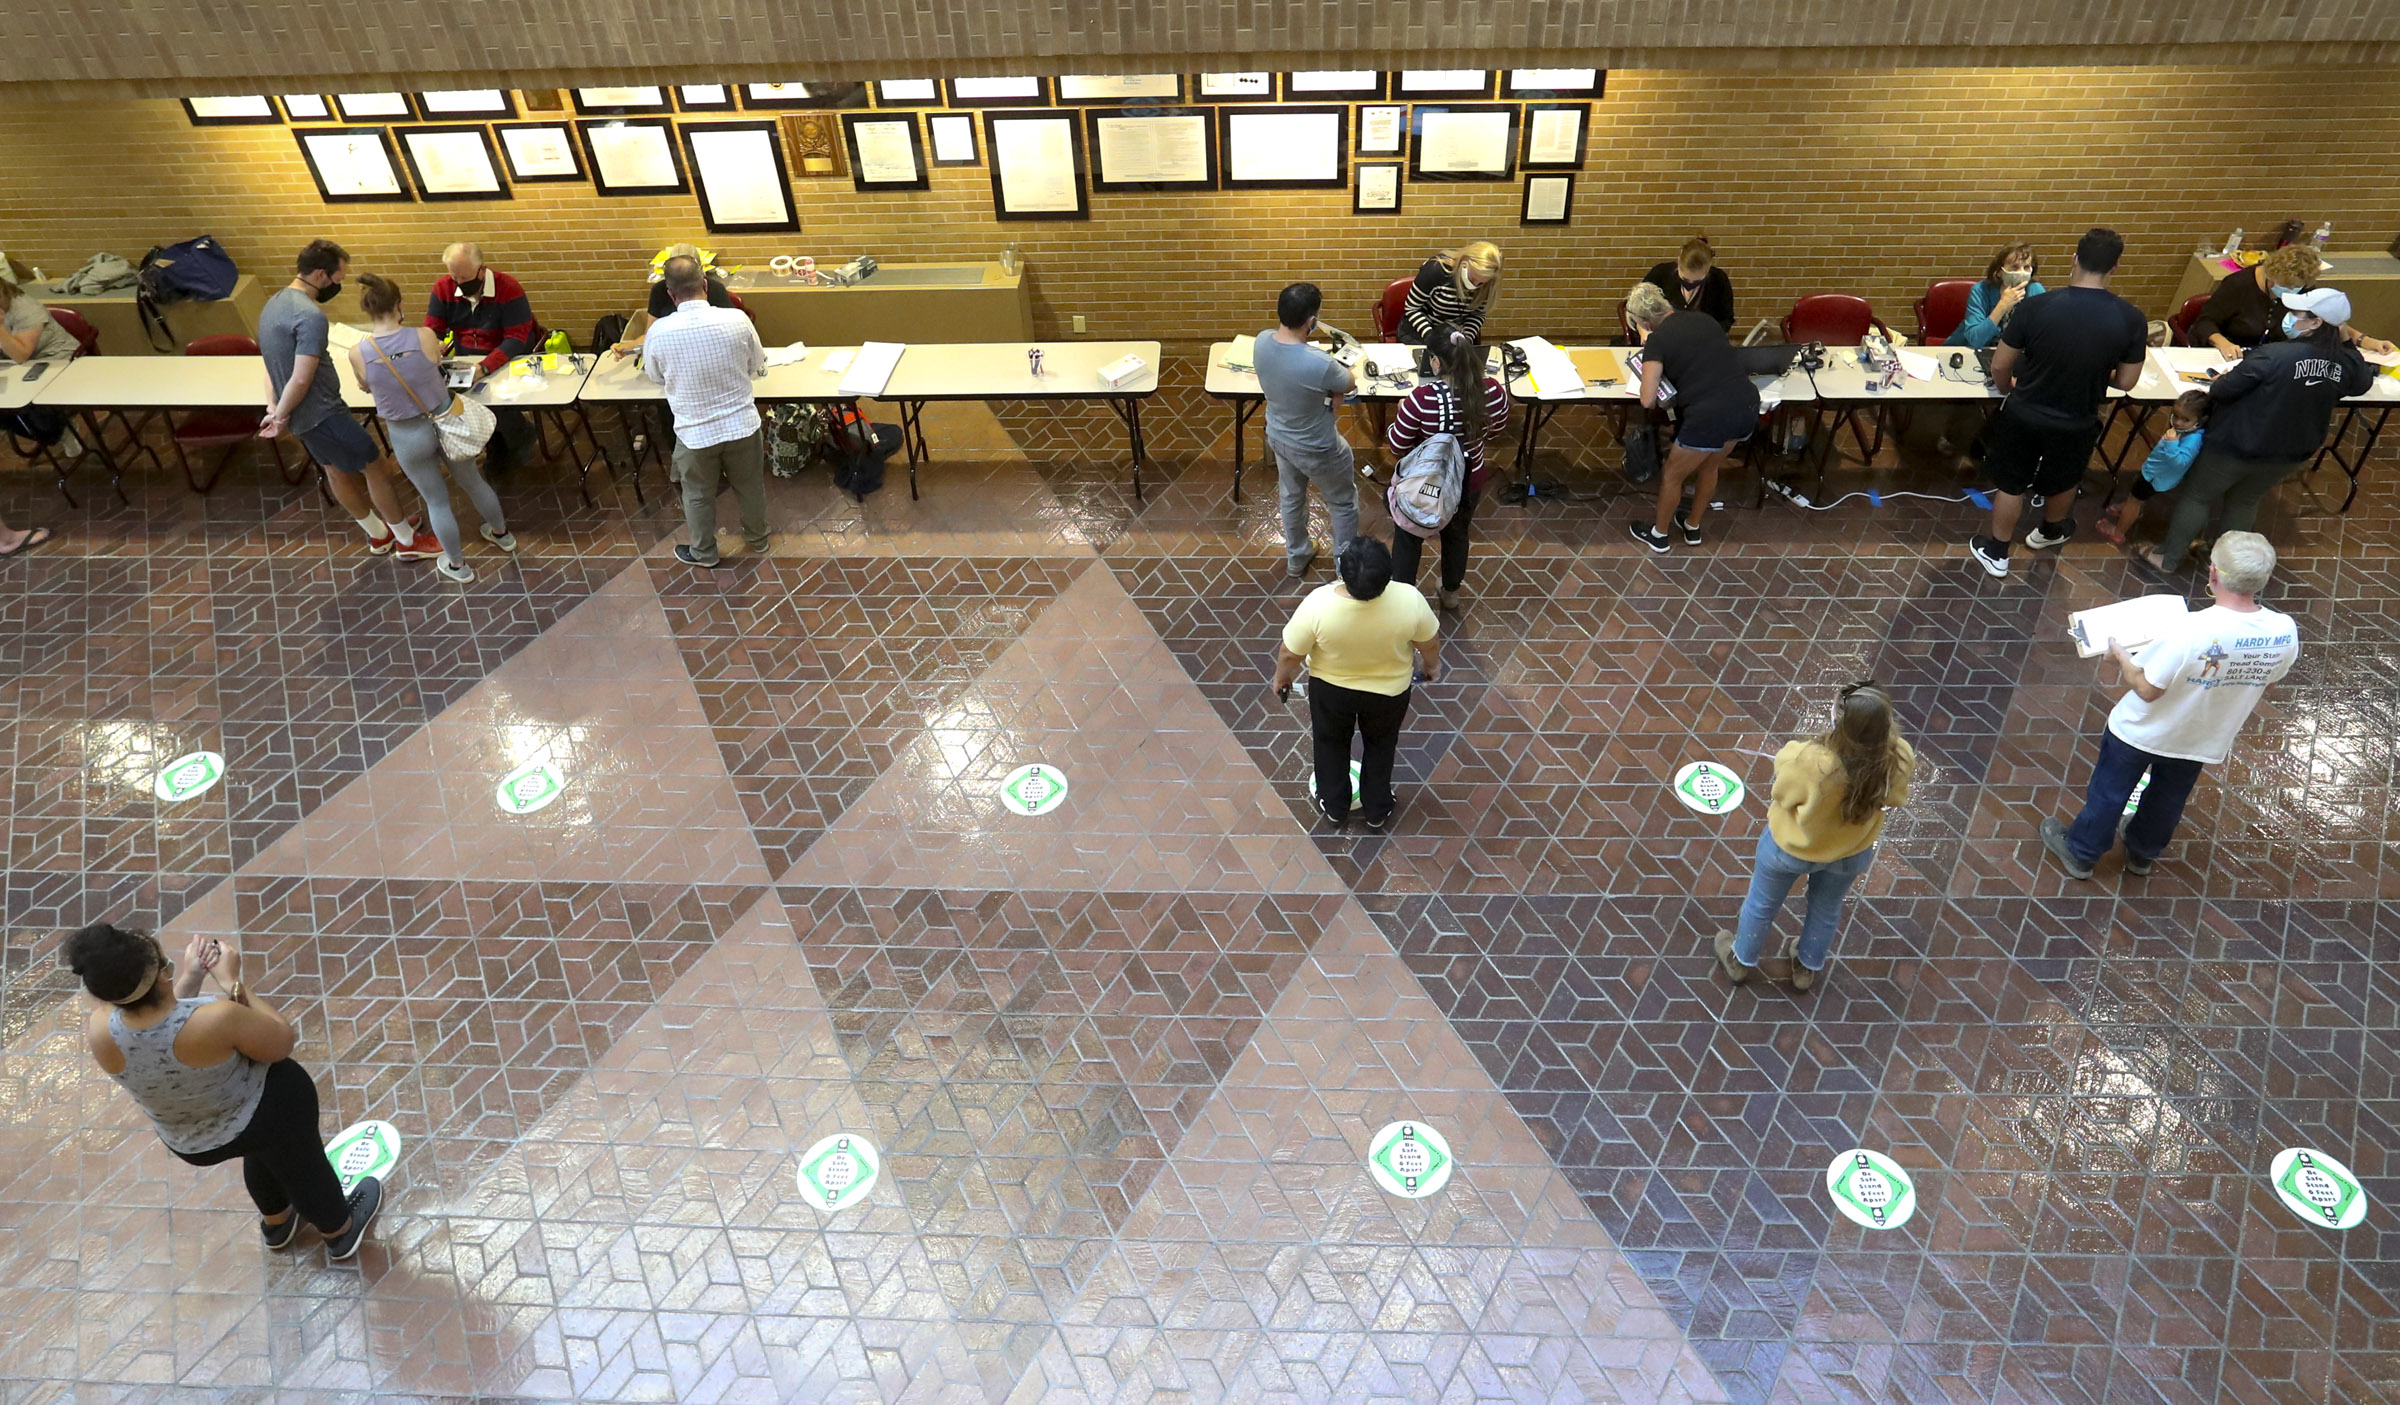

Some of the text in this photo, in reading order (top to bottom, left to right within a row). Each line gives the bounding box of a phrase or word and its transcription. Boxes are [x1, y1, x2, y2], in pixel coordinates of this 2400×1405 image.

[2294, 359, 2341, 382] NIKE
[1420, 484, 1440, 497] PINK
[2235, 635, 2292, 648] HARDY MFG
